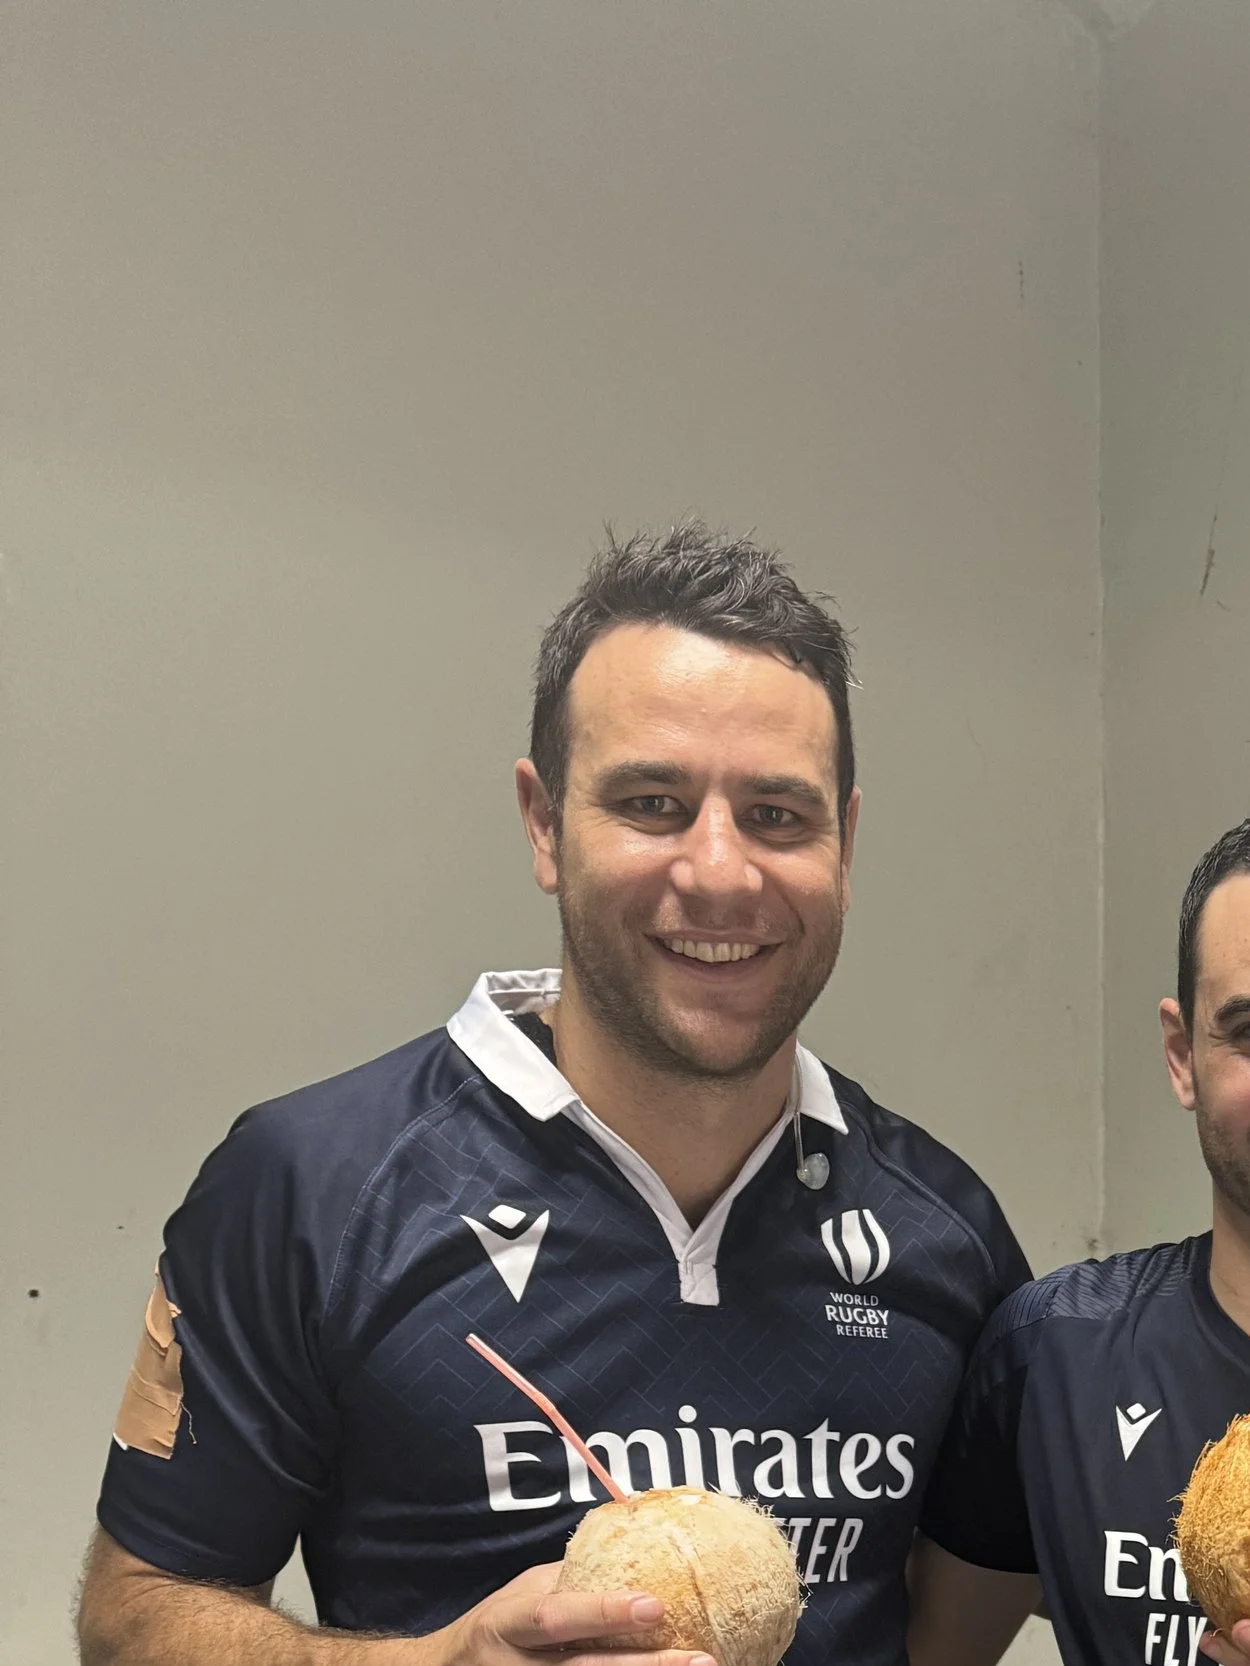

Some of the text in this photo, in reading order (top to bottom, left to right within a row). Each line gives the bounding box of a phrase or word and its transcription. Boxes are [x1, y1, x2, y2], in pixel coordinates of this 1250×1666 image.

[830, 1292, 878, 1306] WORLD
[825, 1305, 889, 1325] RUGBY
[836, 1325, 888, 1338] REFEREE
[473, 1405, 916, 1511] Emirates
[772, 1517, 864, 1583] TER
